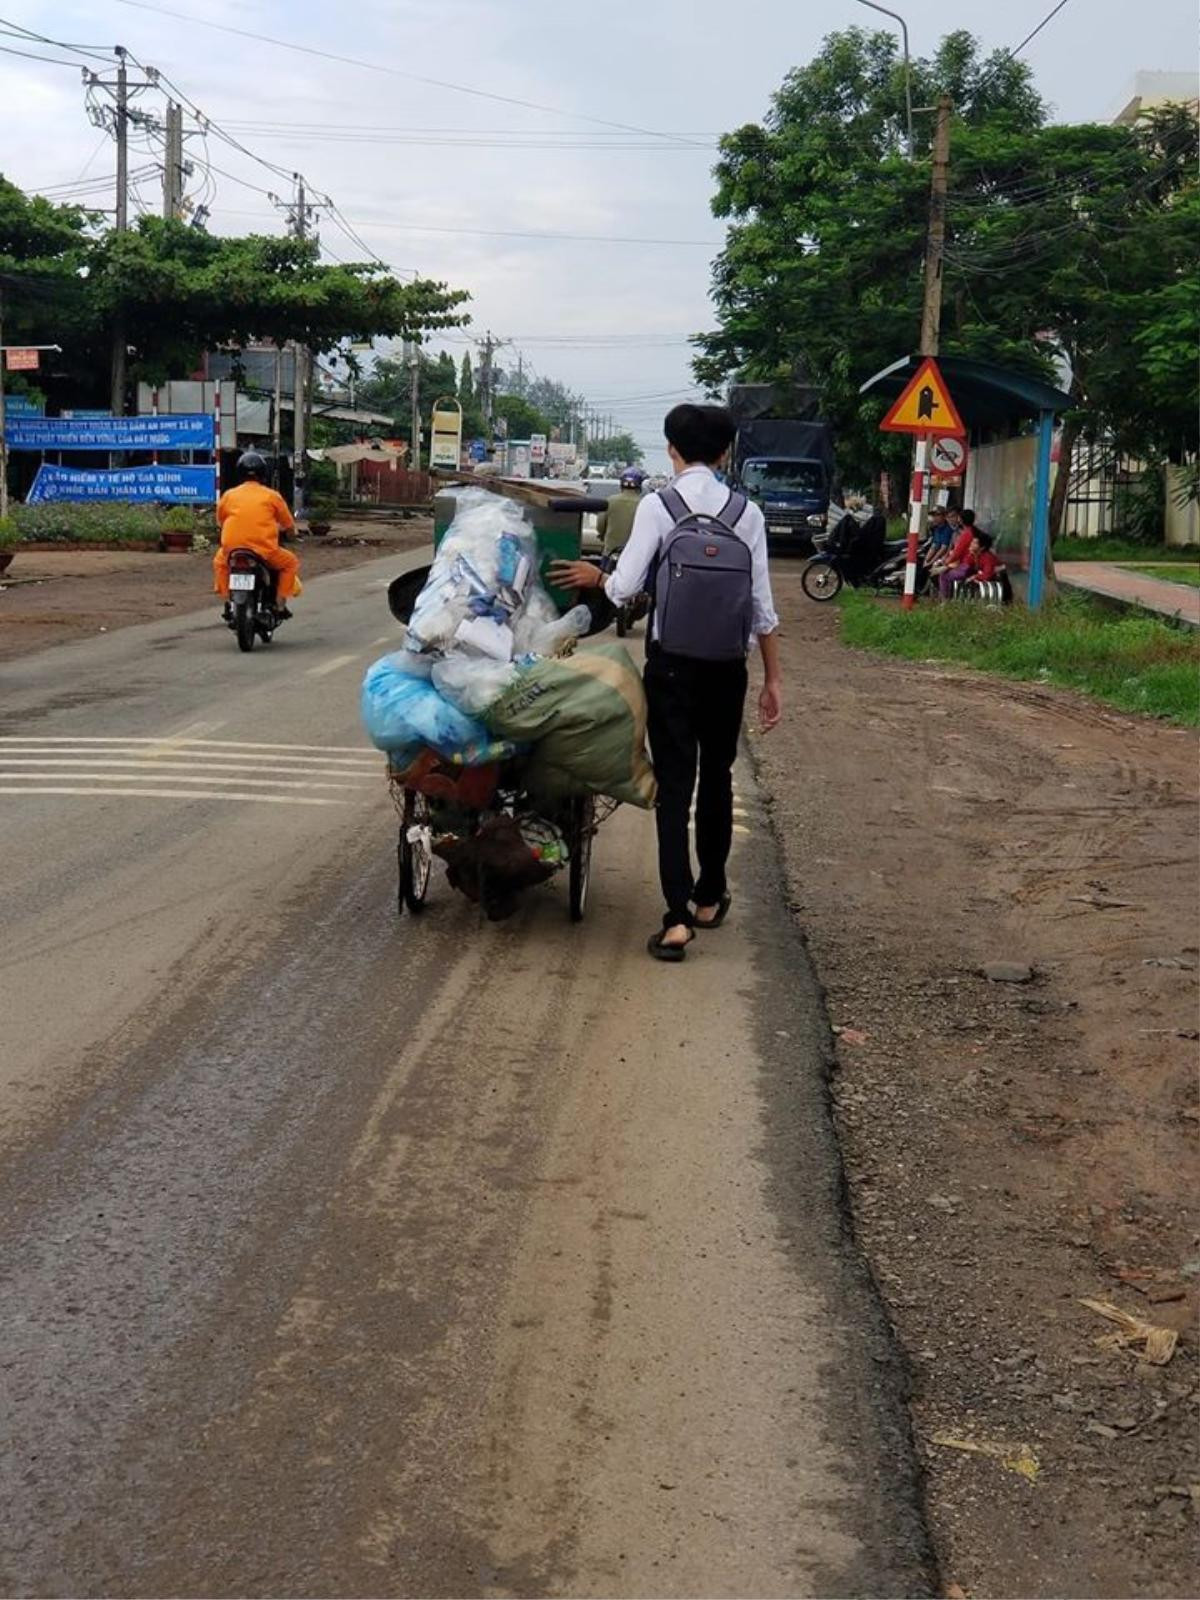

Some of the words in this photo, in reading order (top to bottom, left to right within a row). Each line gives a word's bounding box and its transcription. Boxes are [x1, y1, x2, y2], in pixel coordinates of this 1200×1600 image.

[69, 472, 97, 482] HIỂM
[99, 474, 106, 482] Y
[109, 472, 121, 483] TẾ
[122, 473, 136, 484] HỘ
[138, 472, 155, 482] GIA
[157, 471, 182, 482] ĐÌNH
[87, 482, 109, 495] BẢN
[111, 484, 137, 496] THÂN
[139, 484, 152, 494] VÀ
[154, 486, 172, 495] GIA
[174, 484, 198, 495] ĐÌNH
